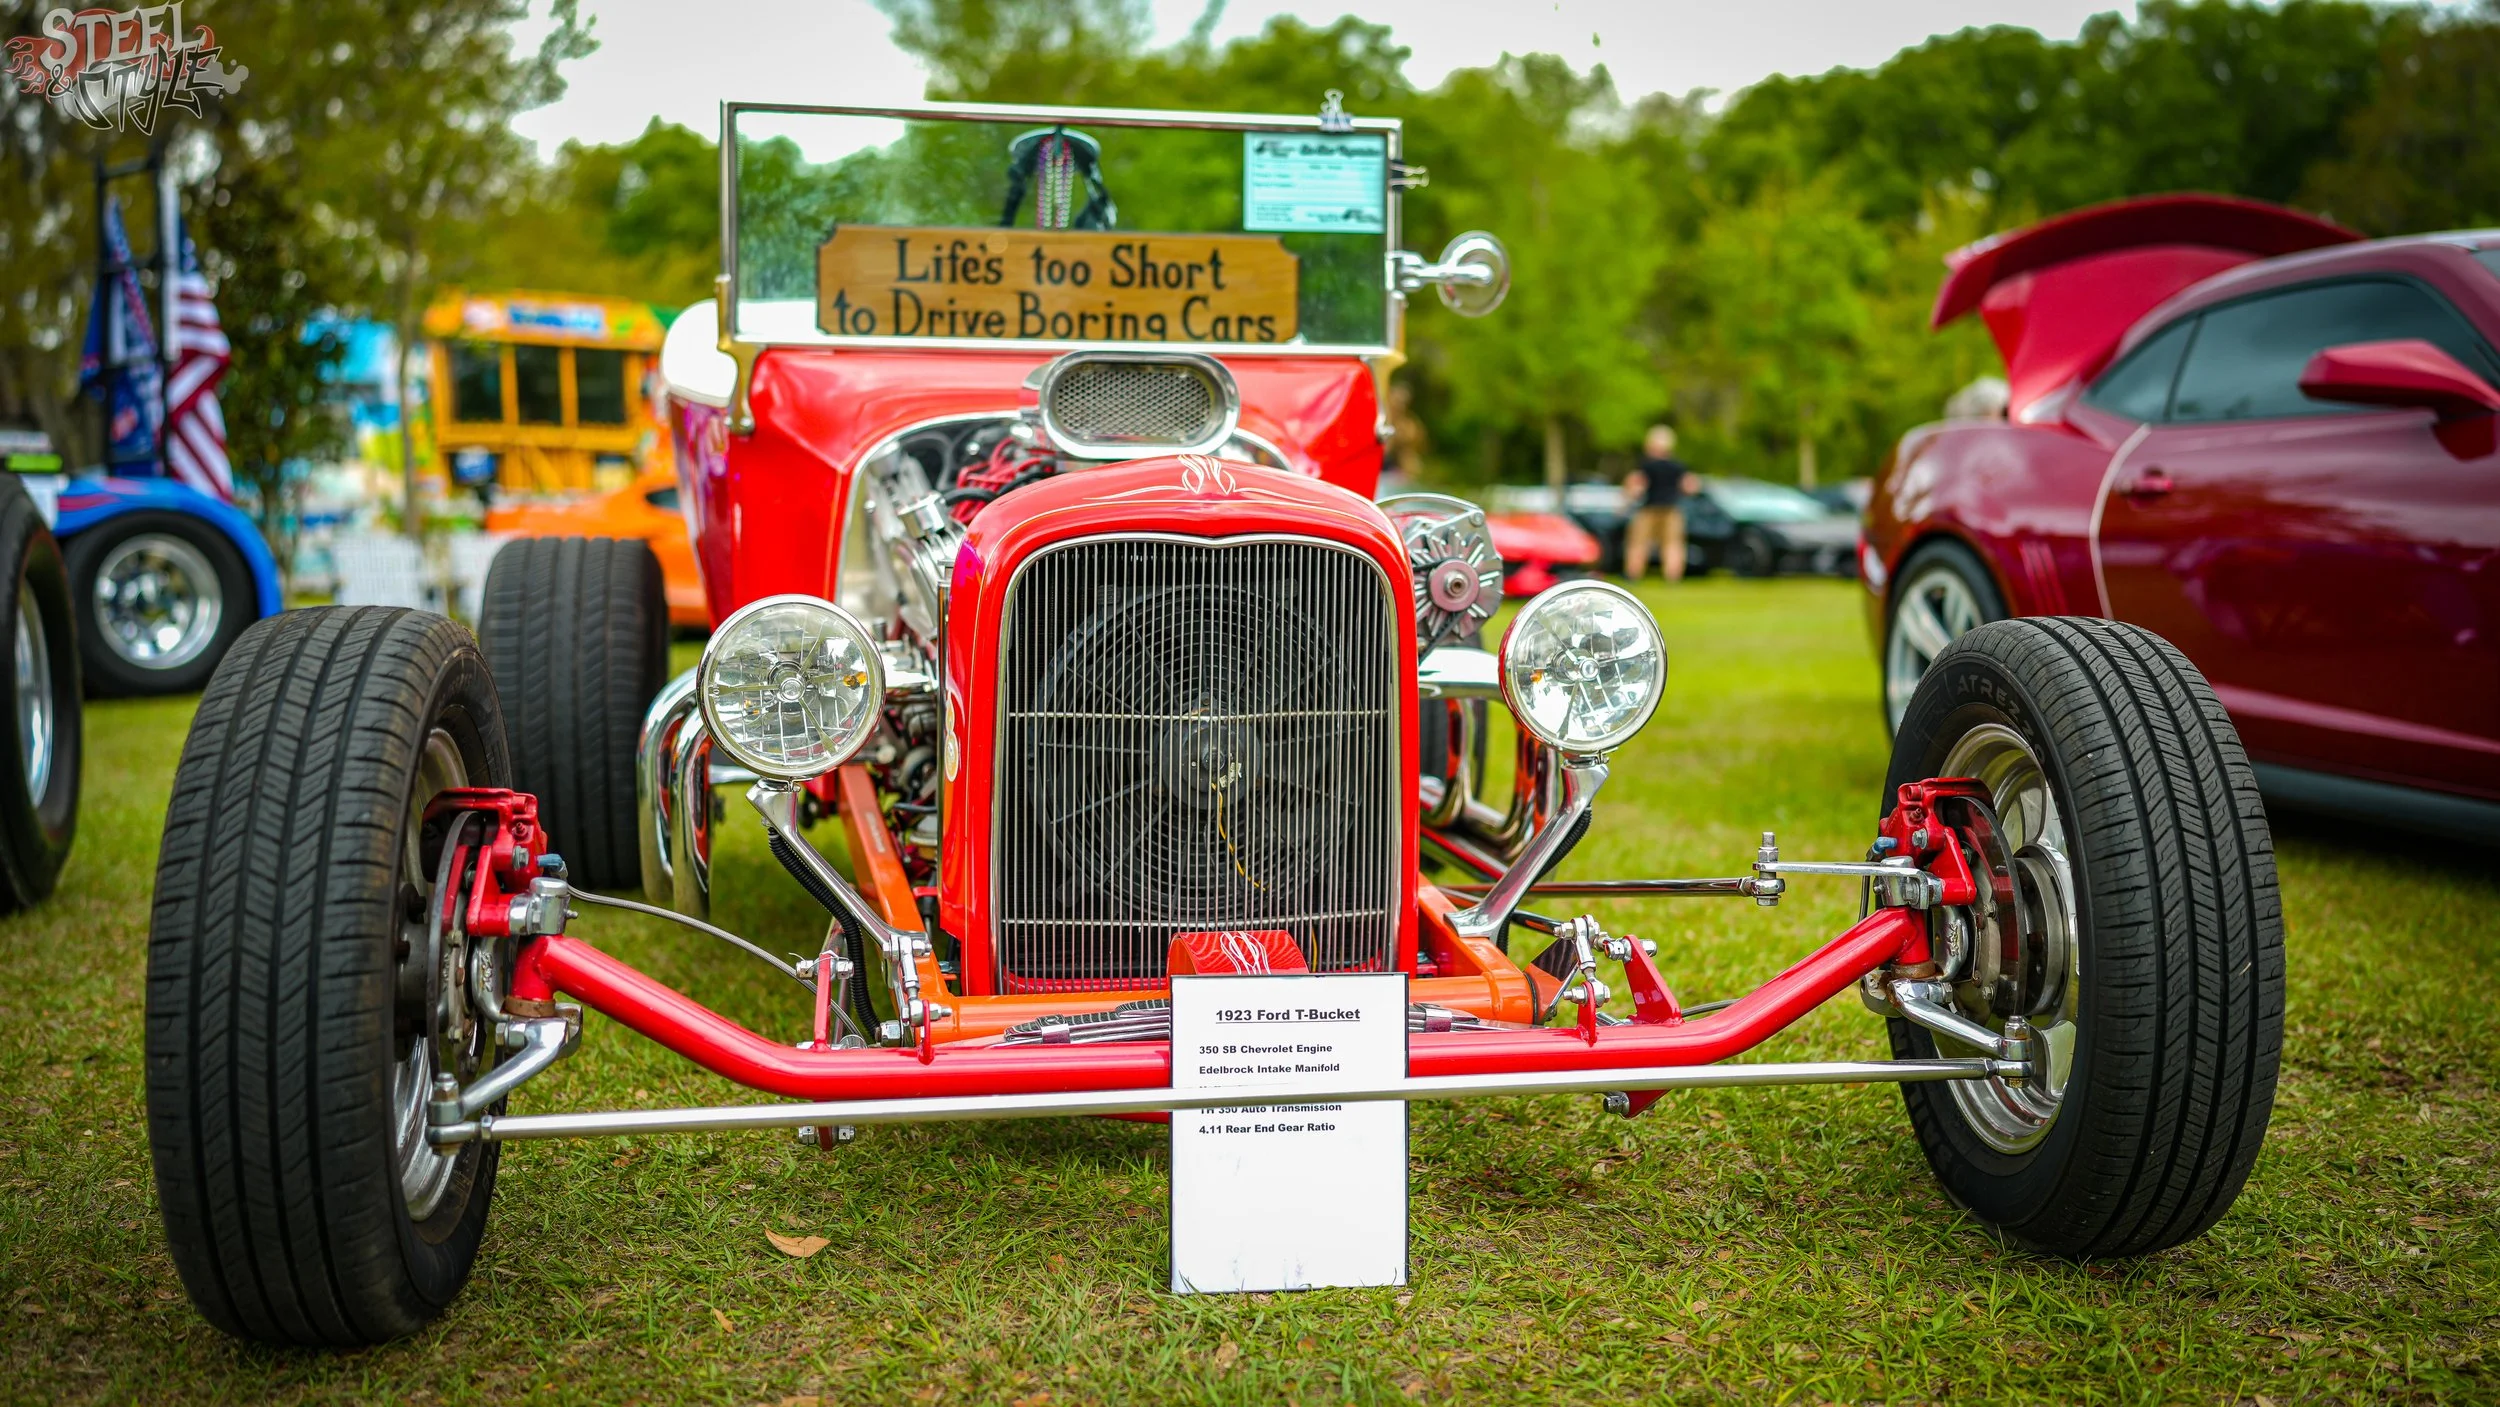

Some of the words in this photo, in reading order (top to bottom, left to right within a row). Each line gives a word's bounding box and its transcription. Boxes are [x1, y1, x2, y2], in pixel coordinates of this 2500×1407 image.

[895, 238, 1003, 284] Life's
[1031, 246, 1091, 287] too
[1110, 243, 1226, 290] Short
[833, 288, 876, 335] to
[892, 289, 1006, 338] Drive
[1181, 295, 1277, 343] Cars
[1216, 1010, 1252, 1021] 1923
[1257, 1009, 1291, 1021] Ford
[1295, 1008, 1361, 1020] T-Bucket
[1199, 1045, 1219, 1054] 350
[1222, 1045, 1237, 1054] SB
[1240, 1044, 1293, 1054] Chevrolet
[1296, 1043, 1333, 1055] Engine
[1199, 1066, 1254, 1074] Edelbrock
[1257, 1064, 1292, 1074] Intake
[1295, 1063, 1340, 1073] Manifold
[1240, 1105, 1267, 1113] Auto
[1271, 1102, 1342, 1113] Transmission
[1199, 1125, 1222, 1134] 4.11
[1225, 1124, 1252, 1134] Rear
[1254, 1123, 1275, 1133] End
[1277, 1123, 1305, 1132] Gear
[1307, 1122, 1336, 1132] Ratio
